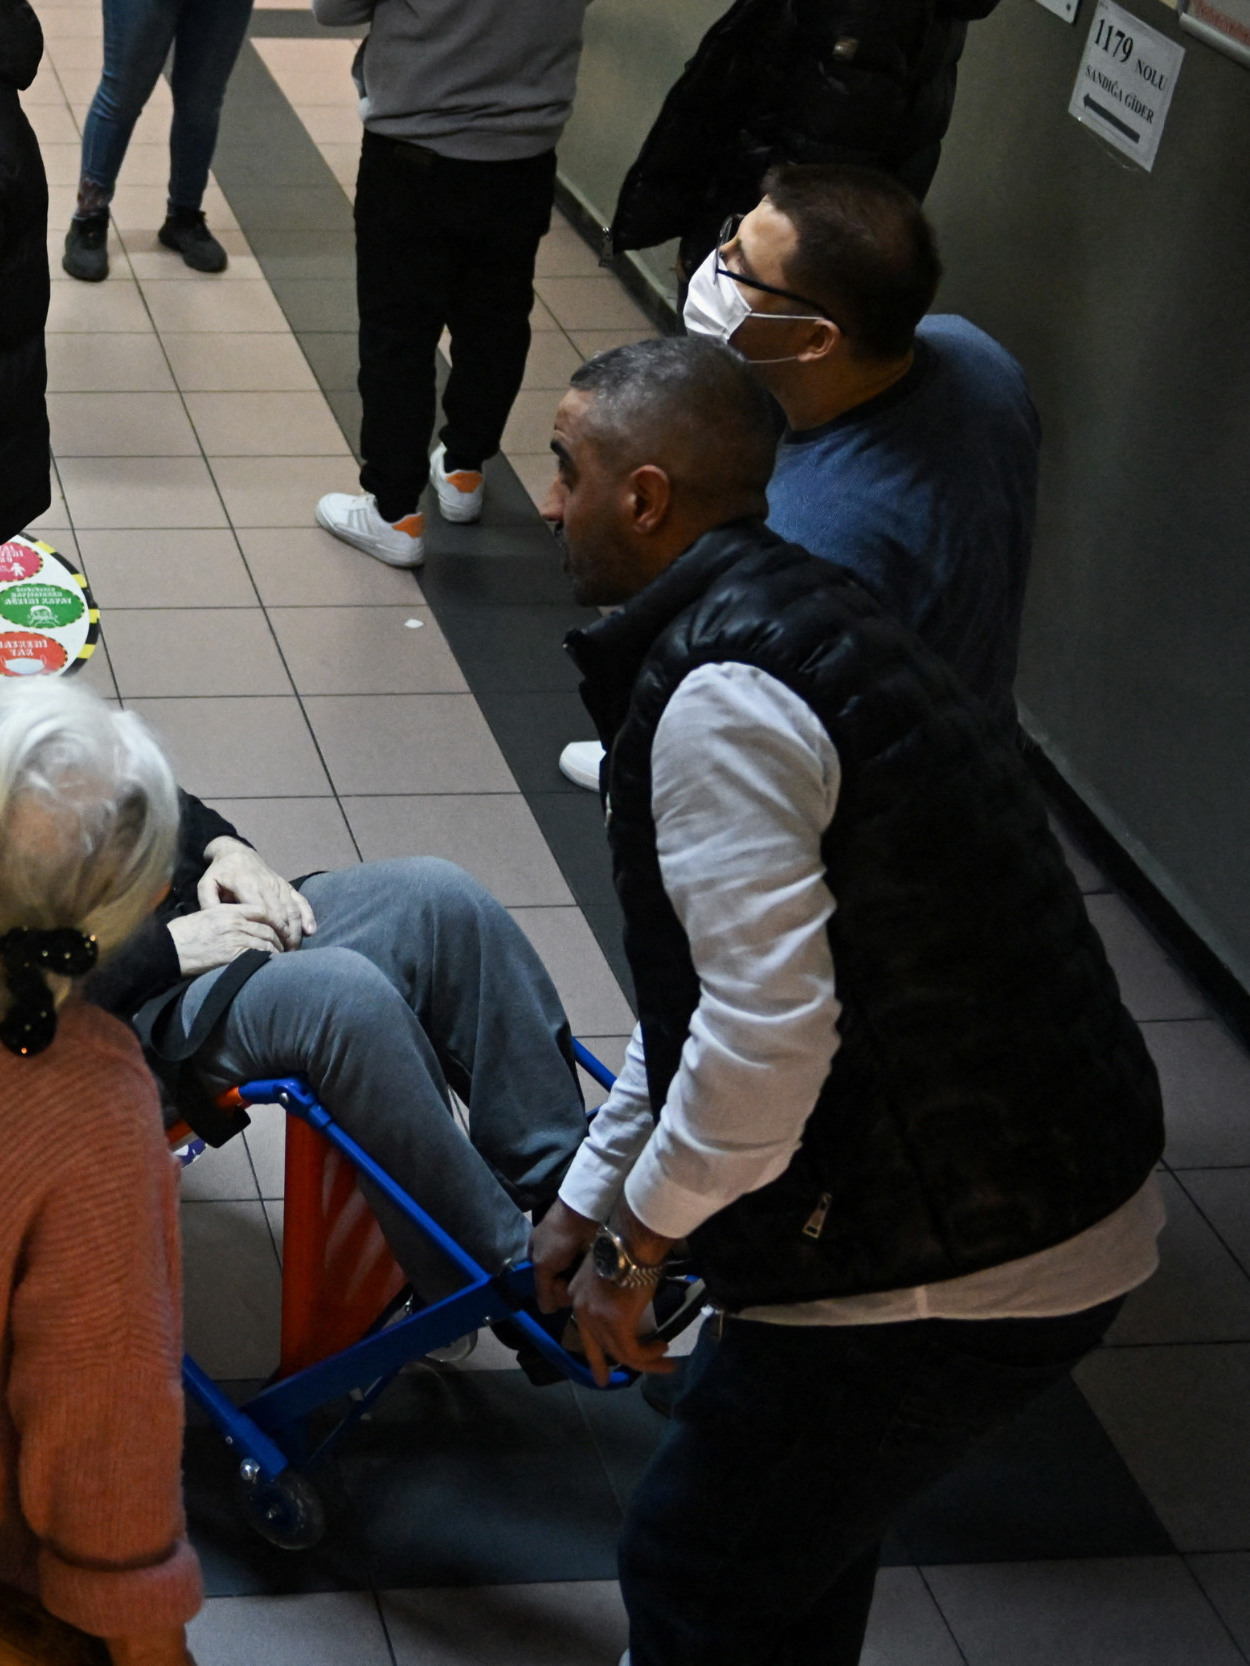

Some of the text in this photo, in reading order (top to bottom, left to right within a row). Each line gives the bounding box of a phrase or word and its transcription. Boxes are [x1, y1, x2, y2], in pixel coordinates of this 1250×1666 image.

[1095, 19, 1168, 91] 1179 NOLU
[1086, 64, 1154, 124] SANDIĞA GİDER
